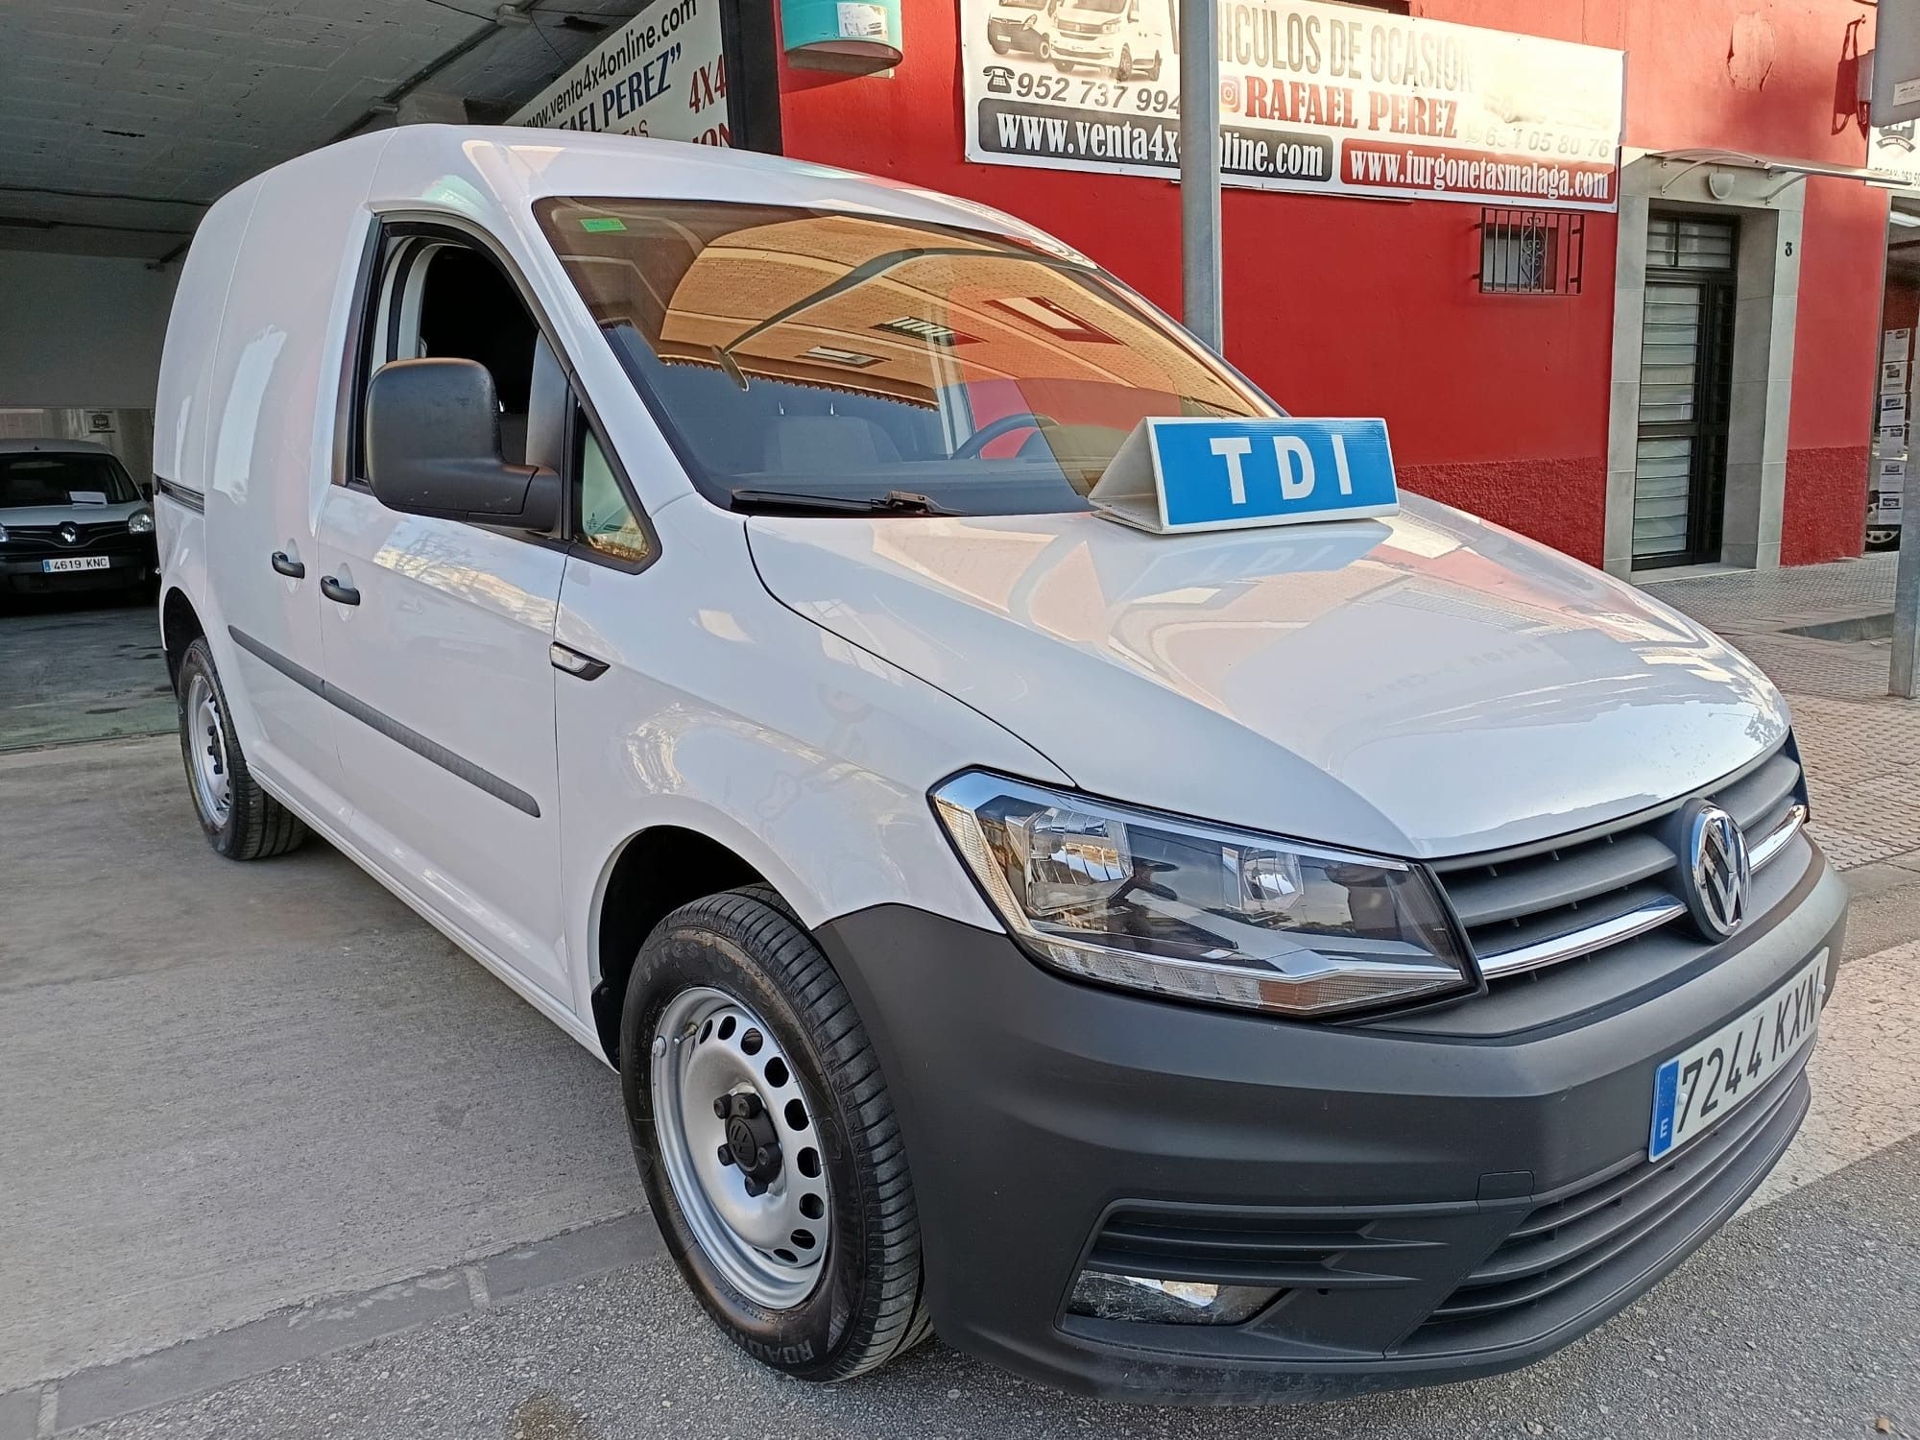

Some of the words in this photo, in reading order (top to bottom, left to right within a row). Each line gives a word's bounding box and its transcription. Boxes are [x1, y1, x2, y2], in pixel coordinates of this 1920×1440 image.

[1329, 18, 1363, 80] DE
[1016, 72, 1071, 103] 952
[1080, 79, 1129, 109] 737
[1136, 87, 1181, 115] 994
[1244, 75, 1358, 130] RAFAEL
[1367, 90, 1458, 138] PEREZ
[1349, 149, 1609, 199] www.furgonetasmalaga.com
[1210, 434, 1353, 504] TDI
[54, 560, 82, 570] 4619
[86, 558, 107, 568] KNC
[1677, 1016, 1764, 1134] 7244
[1772, 966, 1821, 1062] KXN
[1660, 1120, 1668, 1139] E
